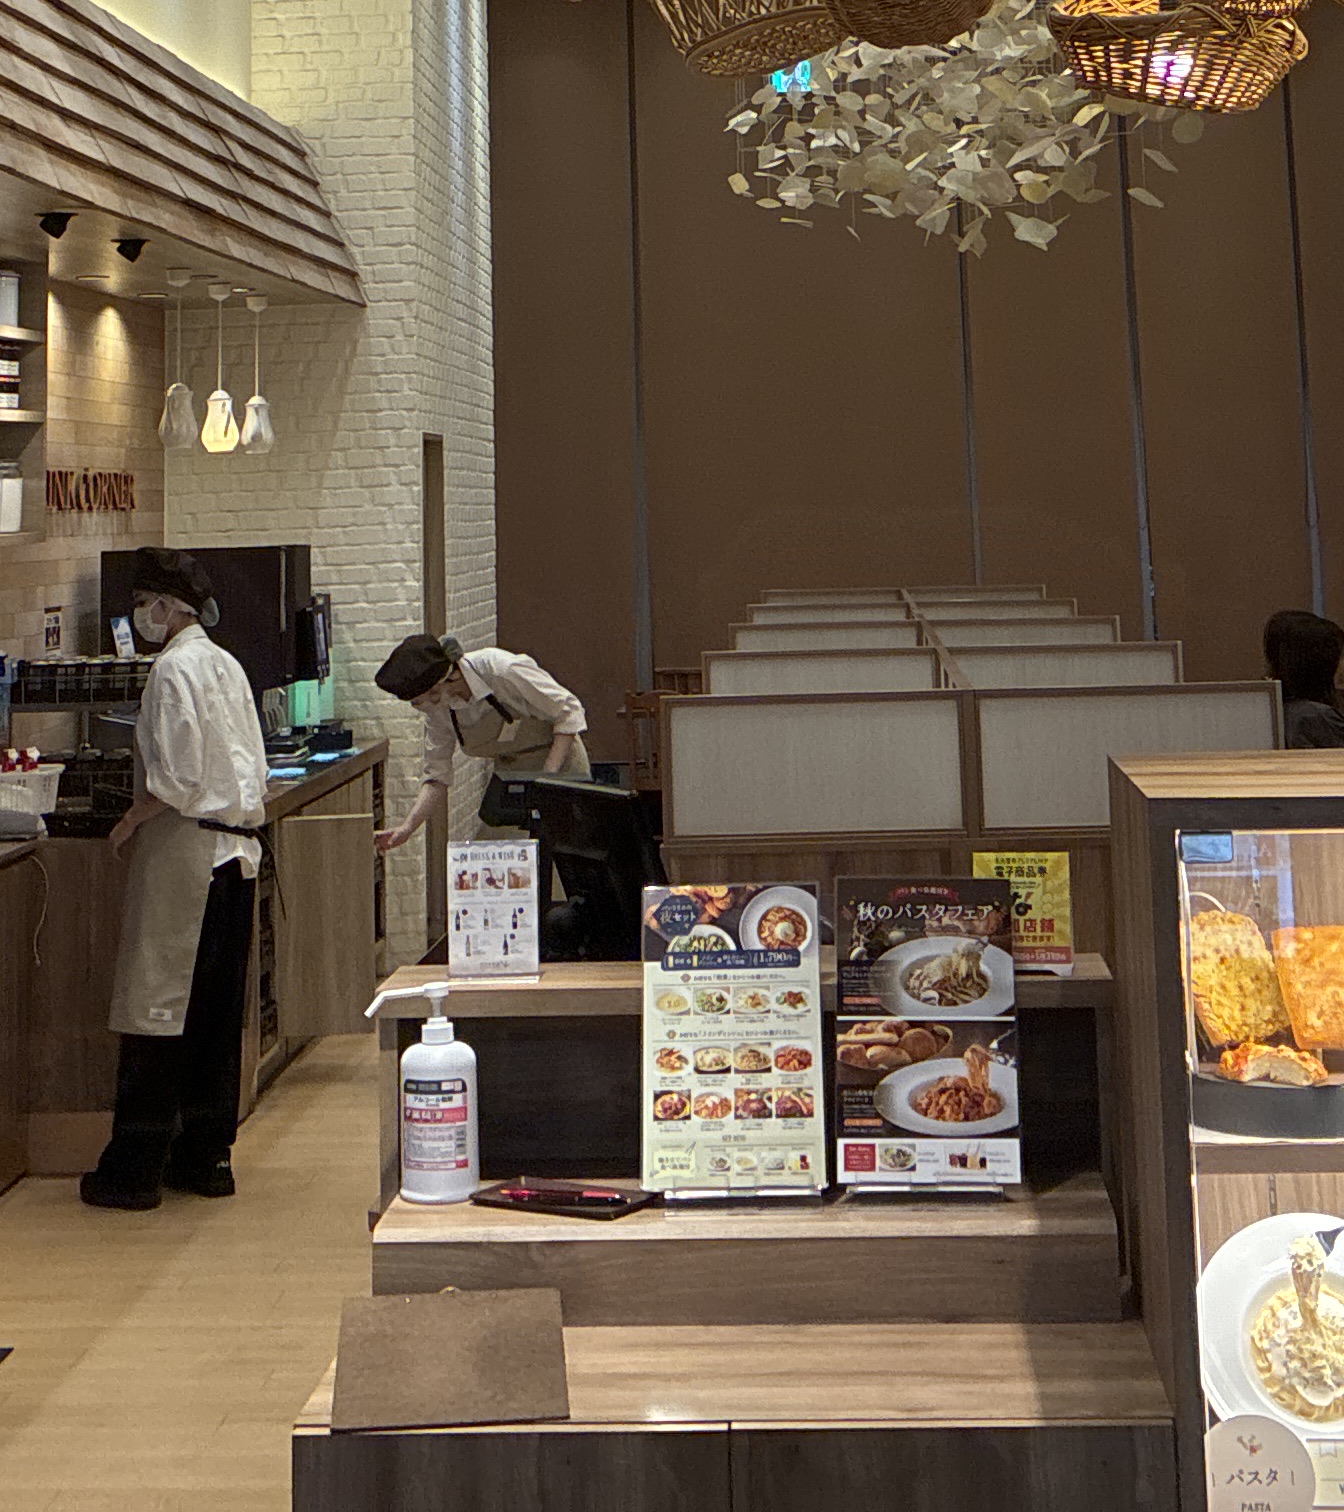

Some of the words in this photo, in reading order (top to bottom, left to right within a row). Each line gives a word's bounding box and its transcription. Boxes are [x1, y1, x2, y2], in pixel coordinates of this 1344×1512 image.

[75, 468, 136, 513] CORNER
[994, 865, 1047, 877] 電子商品券
[857, 902, 993, 921] 秋のパスタフェア
[1225, 1467, 1279, 1487] パスタ
